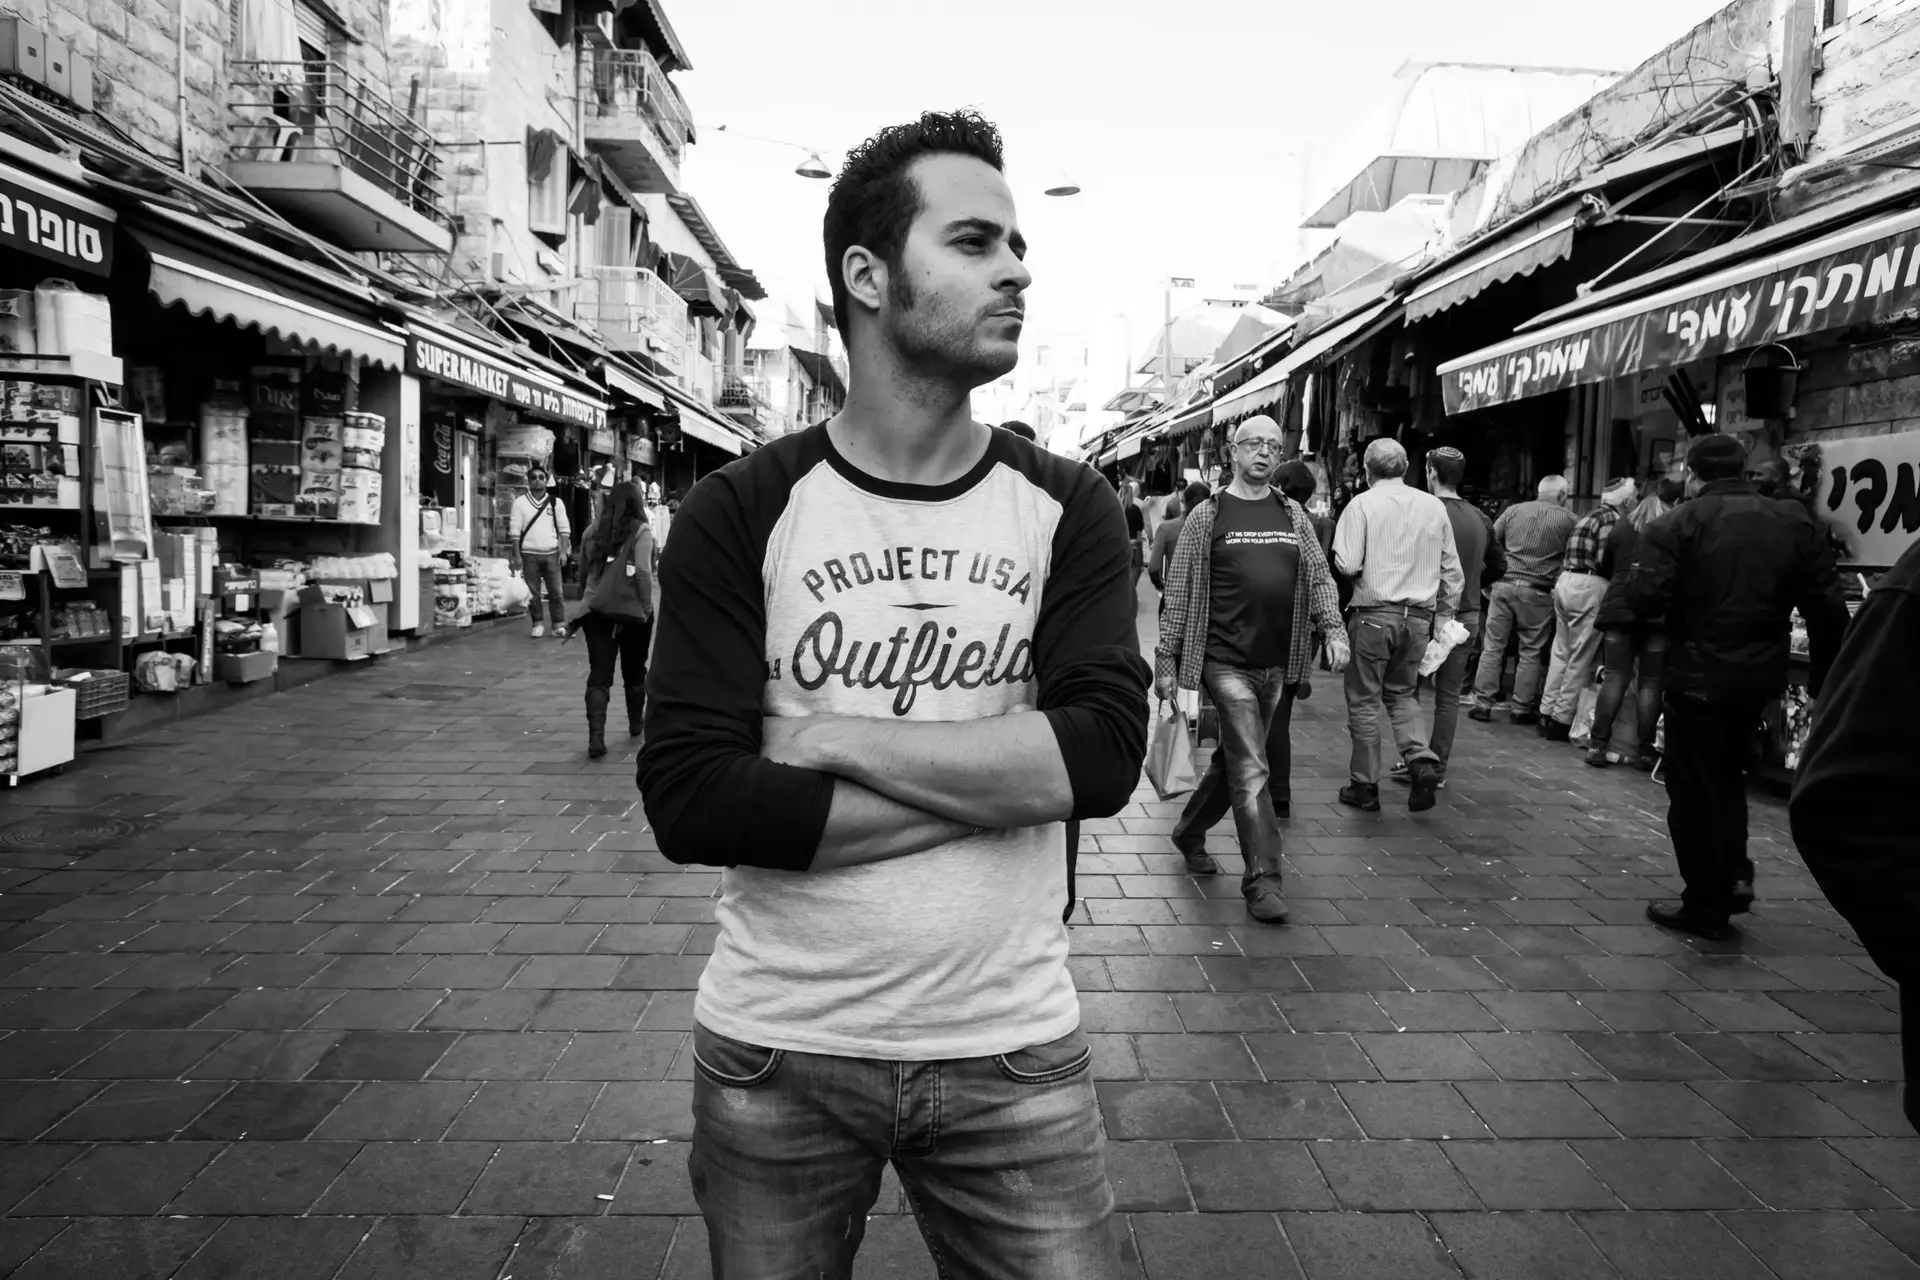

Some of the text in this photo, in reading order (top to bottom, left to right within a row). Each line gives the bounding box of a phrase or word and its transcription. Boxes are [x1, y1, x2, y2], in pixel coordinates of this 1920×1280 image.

[416, 340, 509, 398] SUPERMARKET
[802, 546, 1031, 605] PROJECT USA
